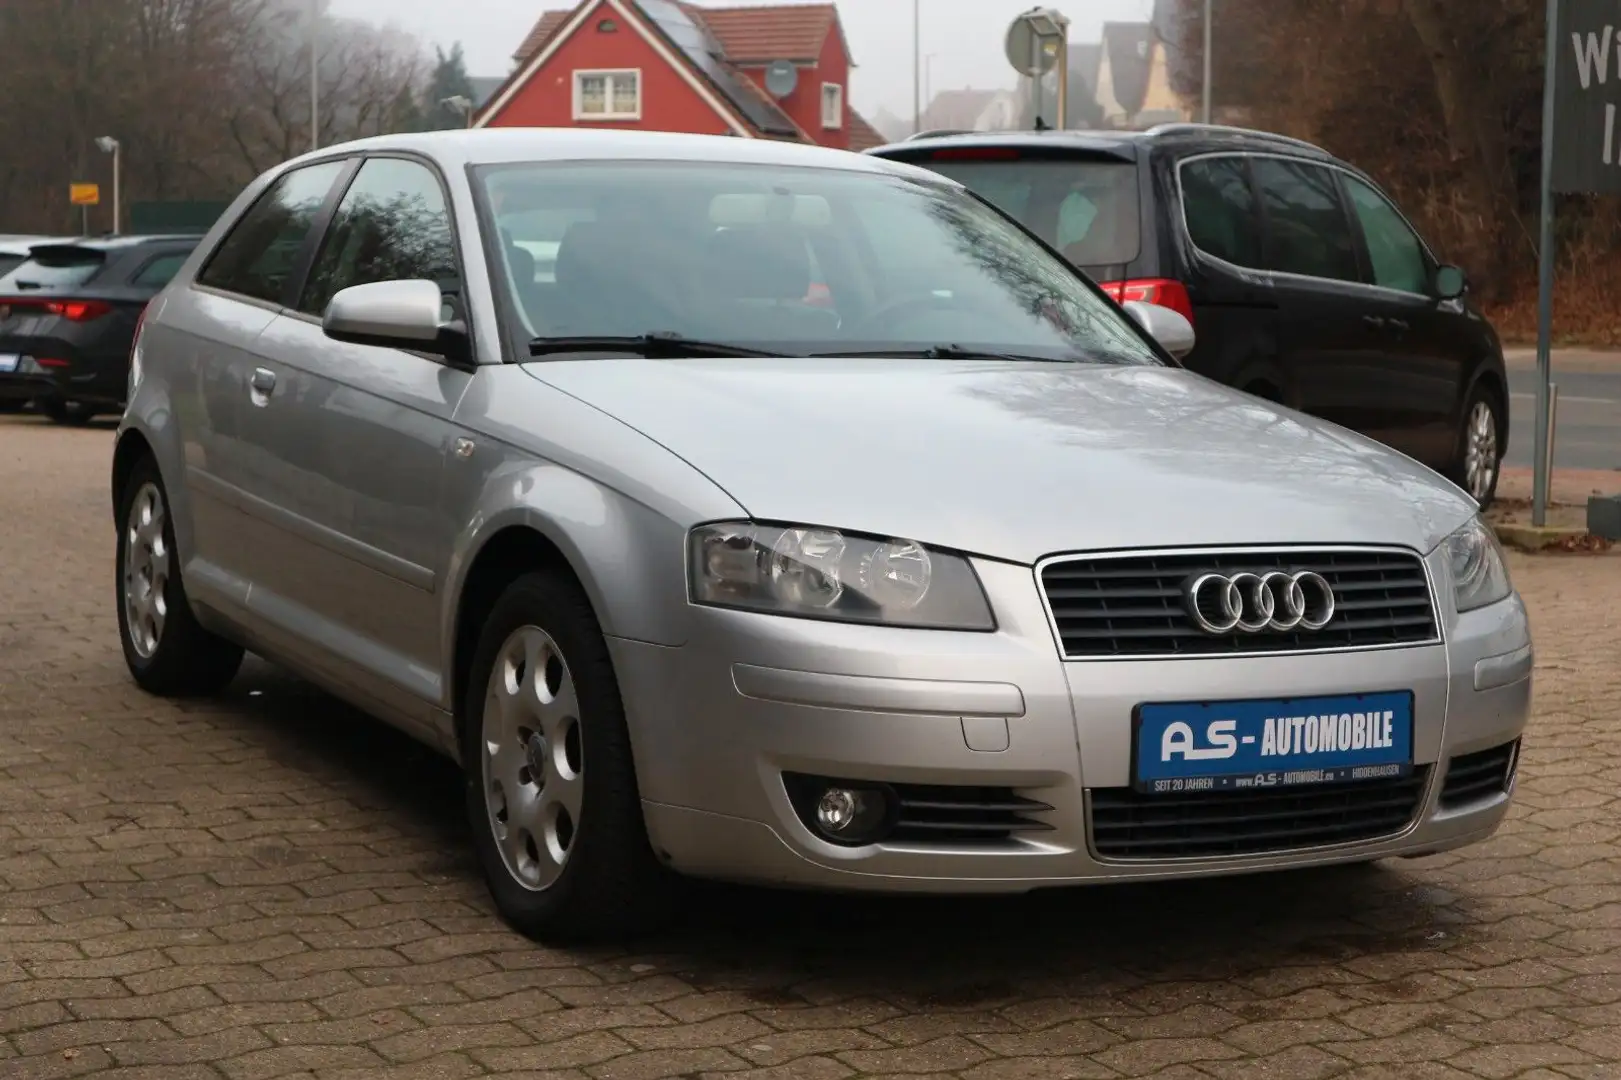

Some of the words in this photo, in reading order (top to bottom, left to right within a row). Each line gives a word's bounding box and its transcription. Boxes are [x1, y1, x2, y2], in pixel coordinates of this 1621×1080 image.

[1603, 103, 1621, 166] I
[1154, 780, 1171, 792] SEIT
[1172, 779, 1184, 791] 20
[1184, 777, 1214, 791] JAHREN
[1352, 764, 1400, 780] HIDDENHAUSEN
